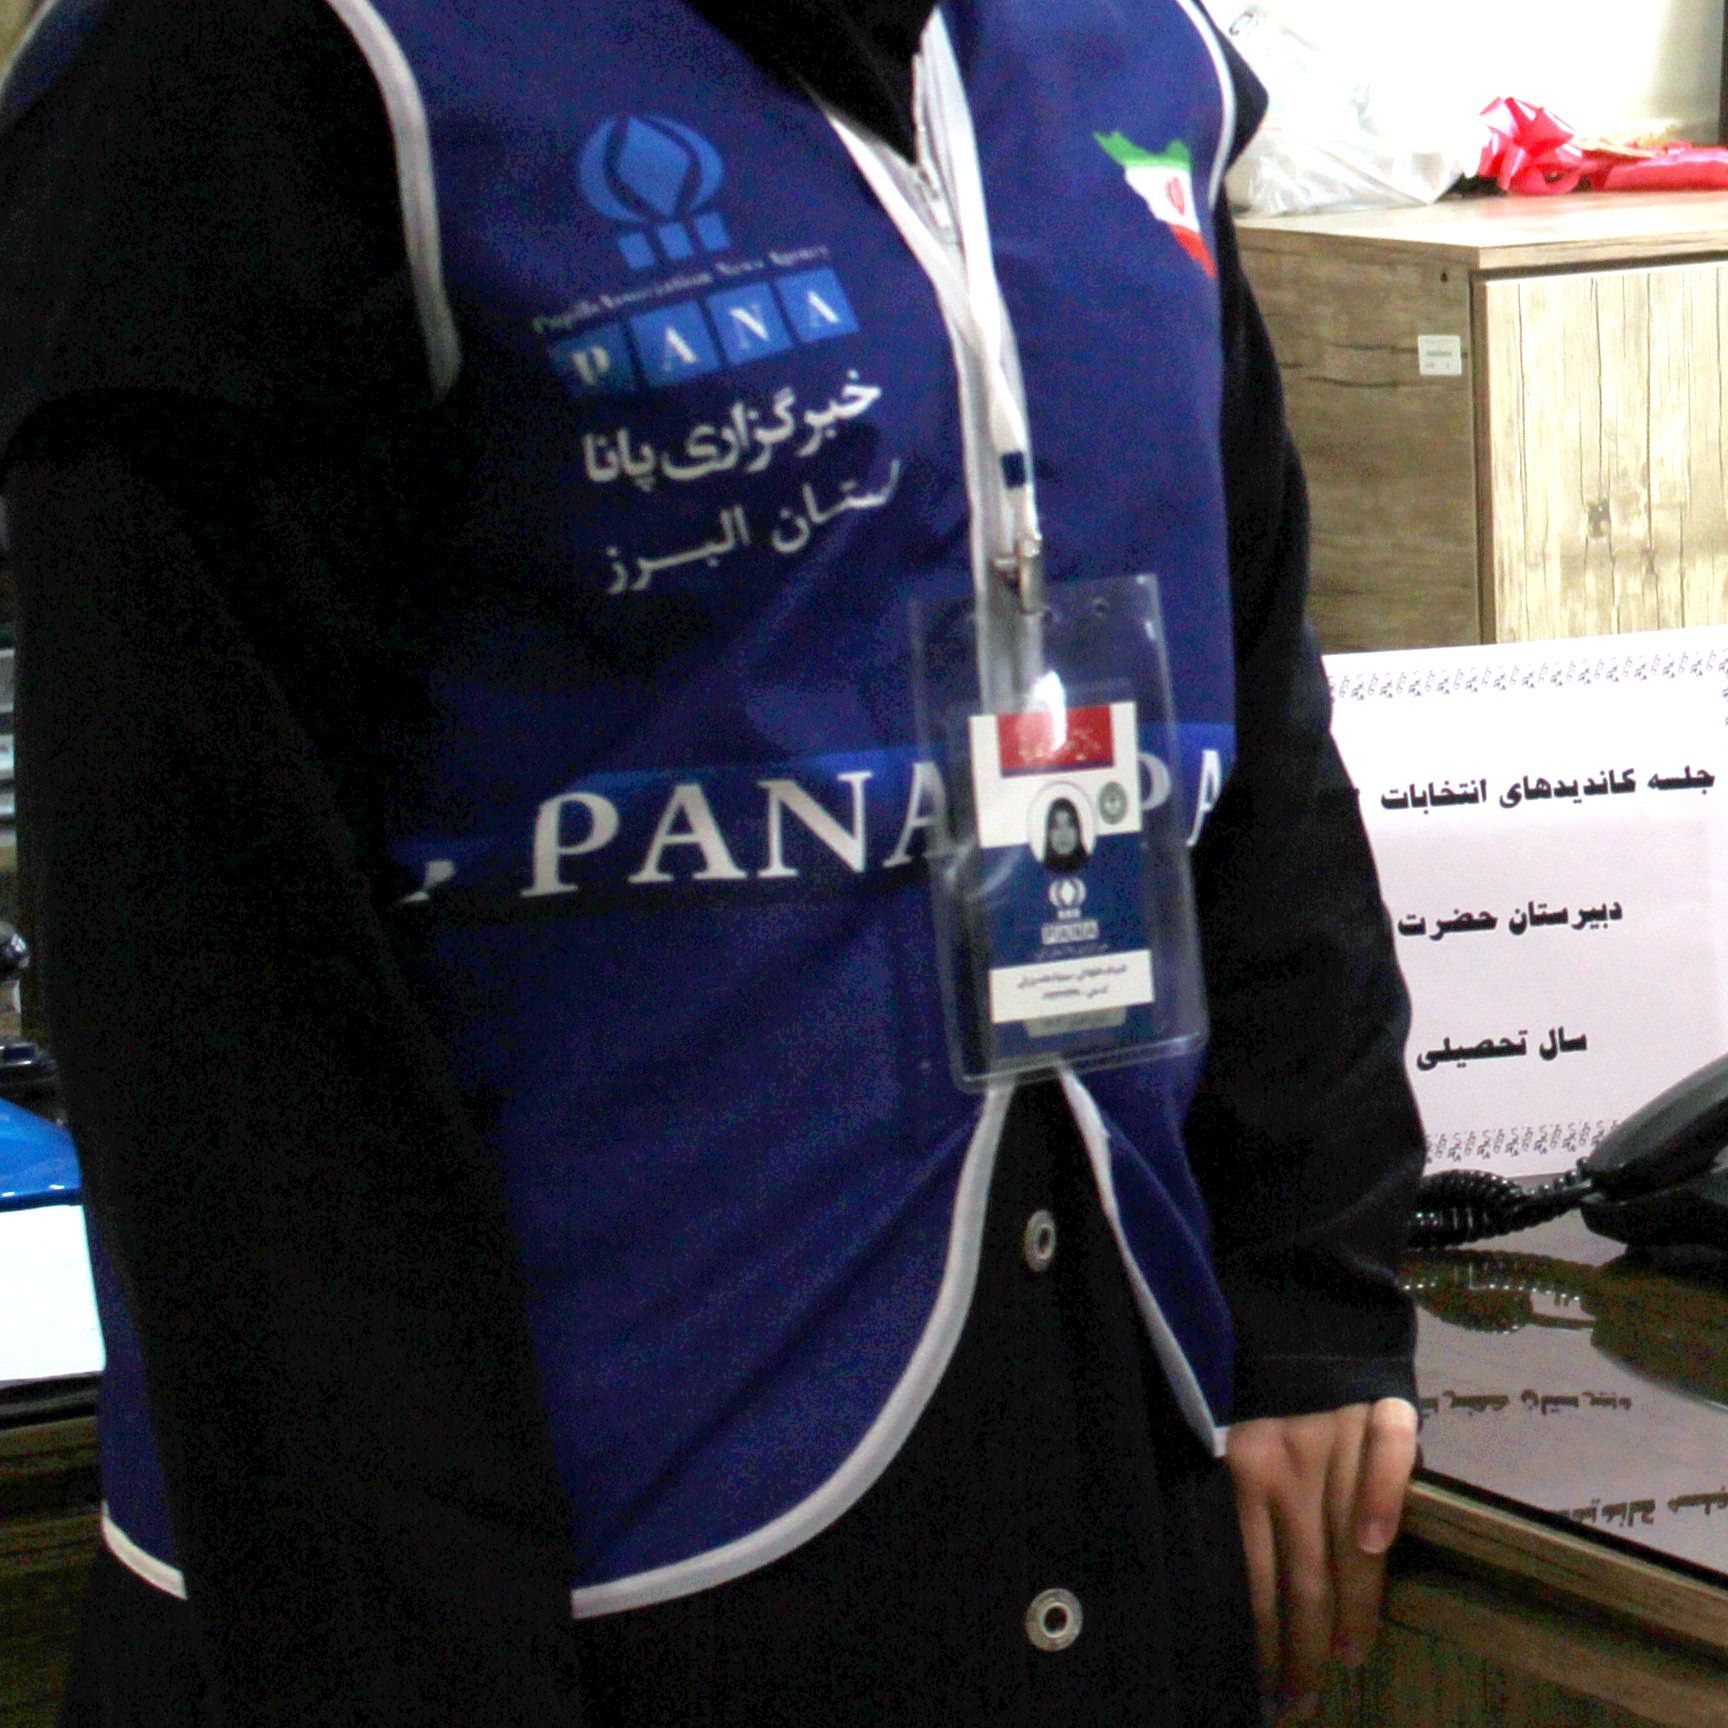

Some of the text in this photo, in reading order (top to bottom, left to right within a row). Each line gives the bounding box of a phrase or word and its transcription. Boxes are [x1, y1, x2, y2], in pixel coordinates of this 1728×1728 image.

[568, 288, 842, 388] PANA
[581, 367, 883, 494] خبرگزاری پانا
[607, 504, 753, 595] البرز
[519, 758, 962, 900] PANA
[1380, 764, 1715, 815] جلسه کاندیدهای انتخابات
[1397, 900, 1624, 942] دبیرستان حضرت
[1416, 1025, 1588, 1071] سال تحصیلی
